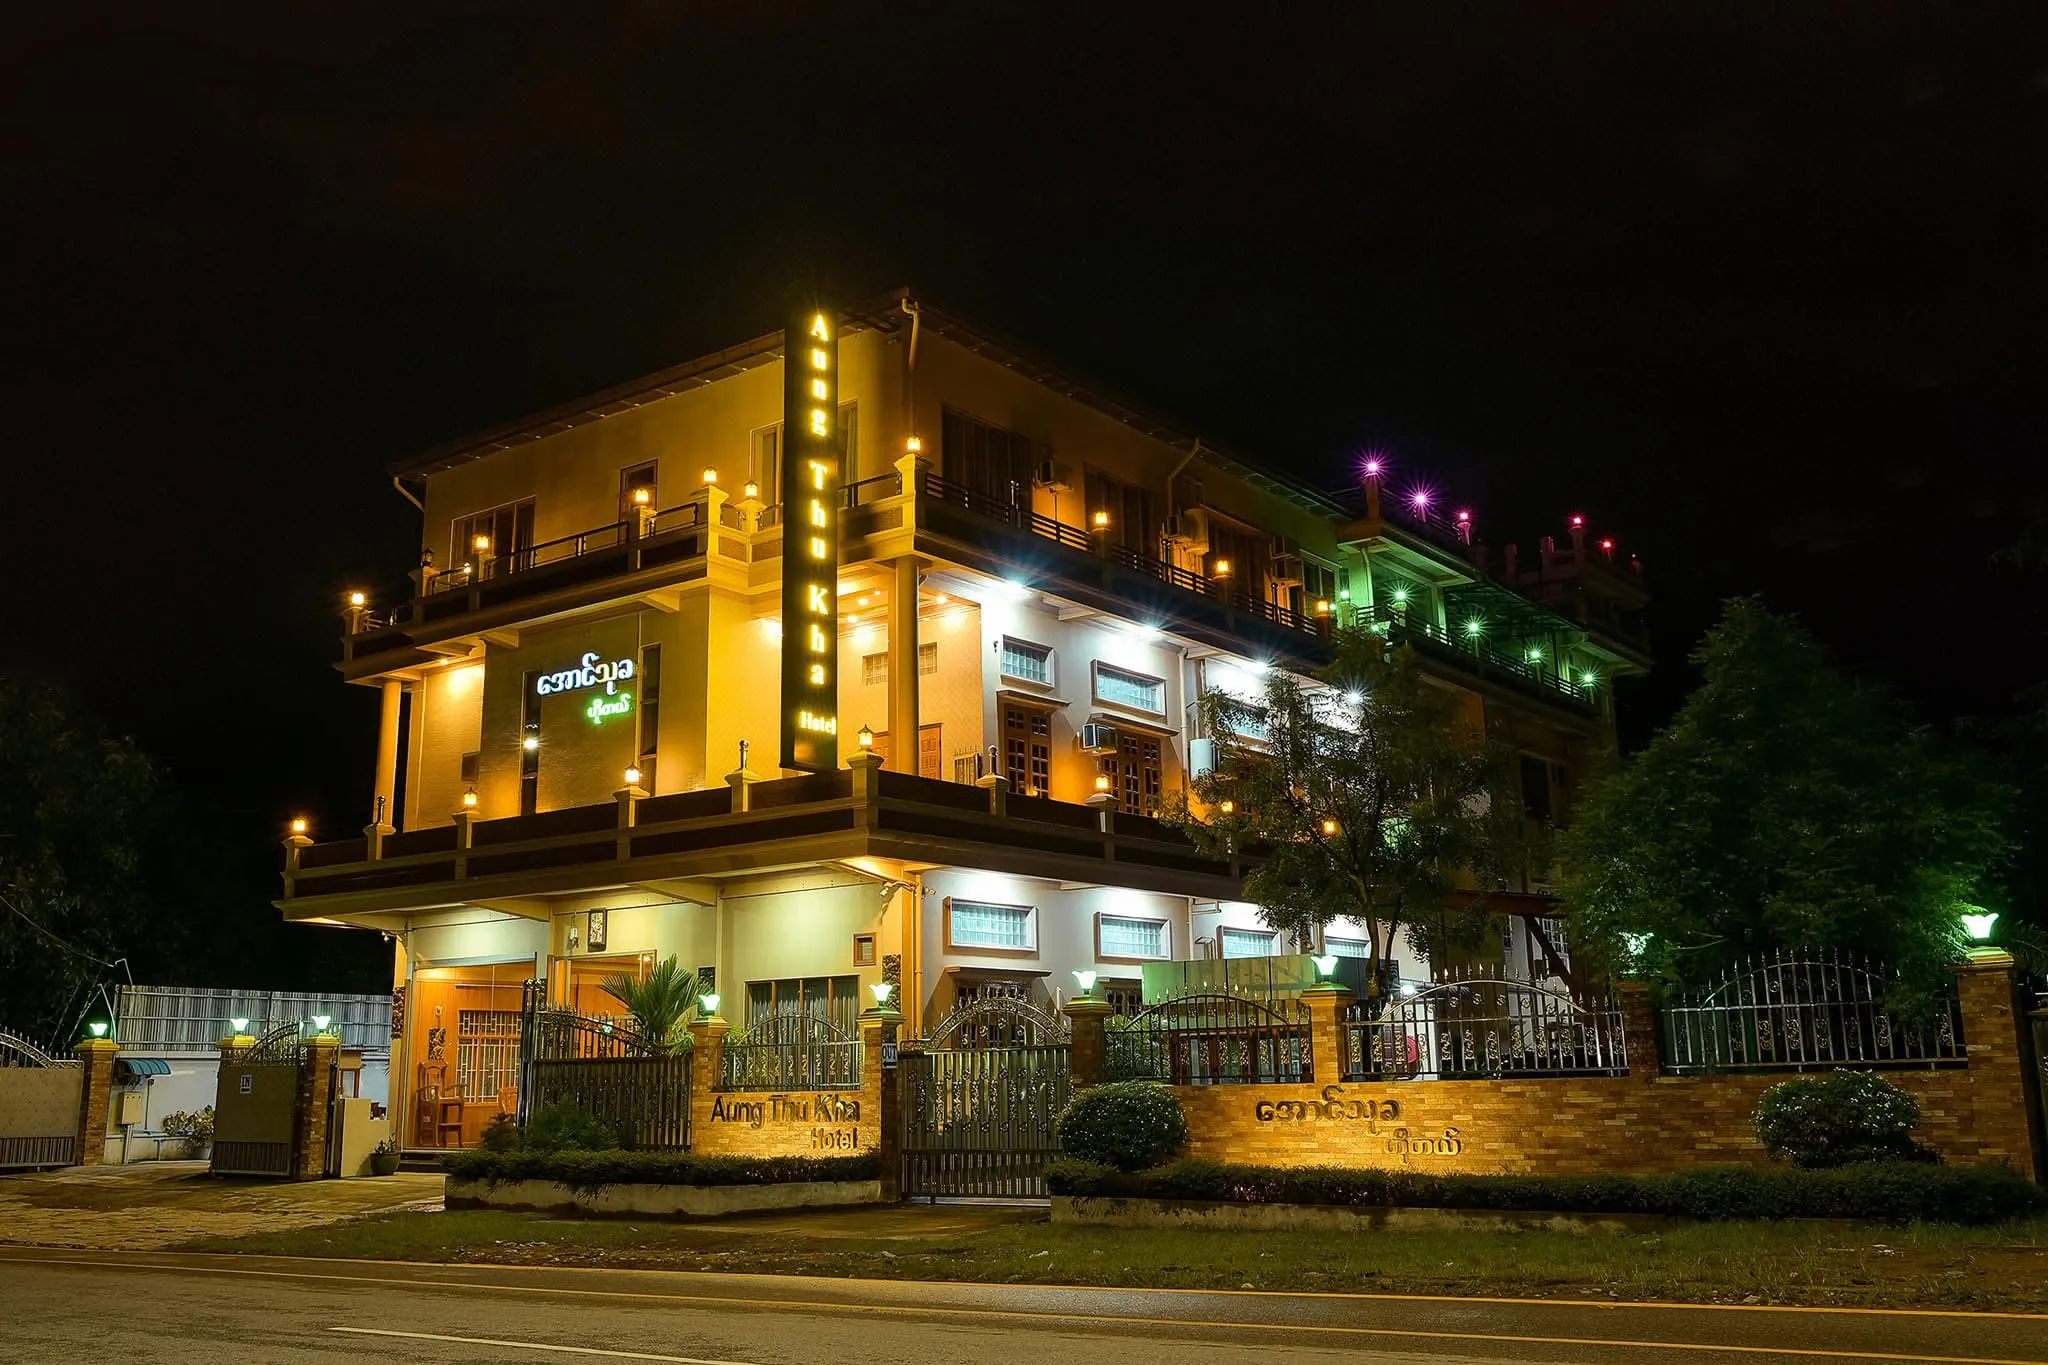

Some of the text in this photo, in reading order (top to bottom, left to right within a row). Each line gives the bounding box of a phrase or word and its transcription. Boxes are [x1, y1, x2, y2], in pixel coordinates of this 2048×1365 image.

[808, 314, 829, 686] Aung Thu Kha
[800, 711, 837, 735] Hotel
[882, 1045, 898, 1060] OUT
[710, 1094, 861, 1128] Aung Thu Kha
[811, 1127, 859, 1149] Hotel
